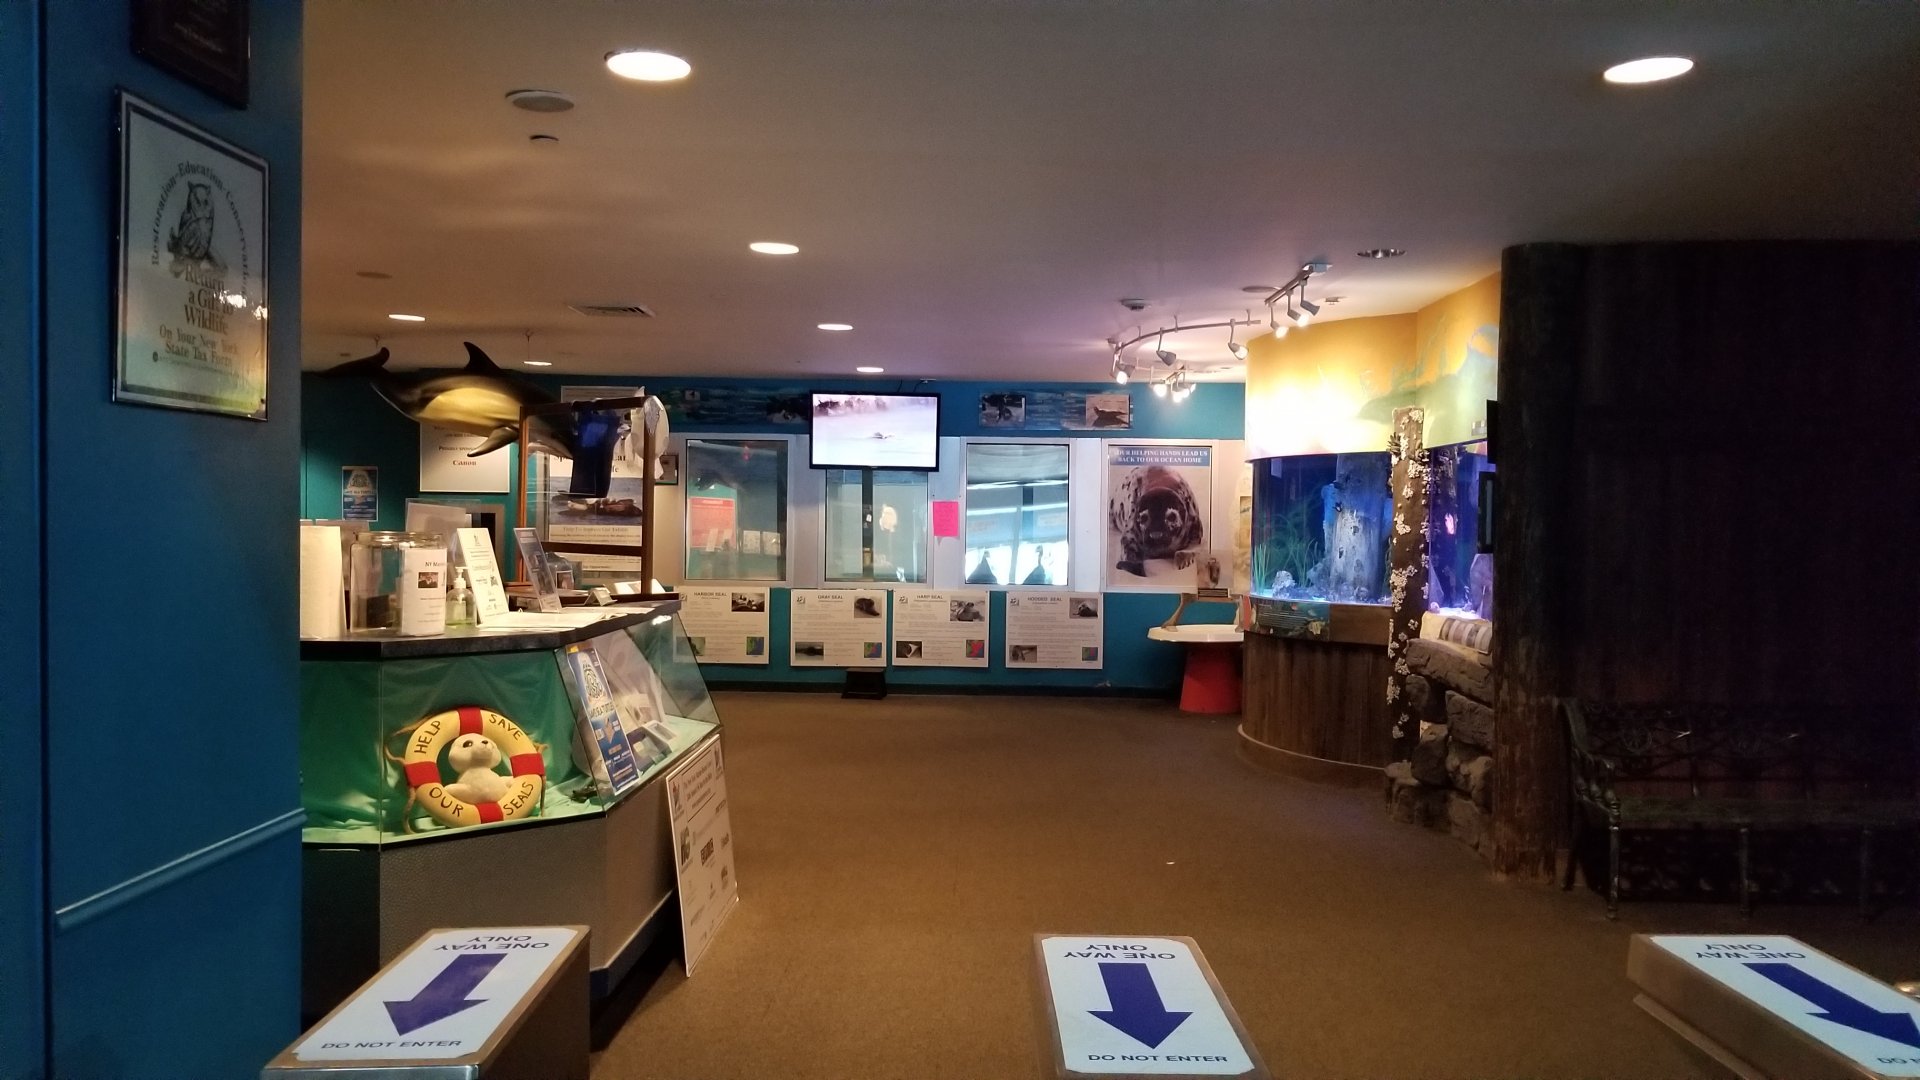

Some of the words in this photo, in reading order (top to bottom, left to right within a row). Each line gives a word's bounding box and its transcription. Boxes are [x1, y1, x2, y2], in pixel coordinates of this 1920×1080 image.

[185, 264, 225, 290] Return
[188, 291, 195, 304] a
[184, 304, 229, 336] Wildlife
[159, 324, 173, 339] On
[177, 327, 196, 345] Your
[165, 341, 189, 357] State
[414, 720, 441, 754] HELP
[489, 713, 523, 741] SAVE
[429, 787, 464, 817] OUR
[503, 781, 534, 816] SEALS
[434, 943, 487, 951] WAY
[1705, 943, 1768, 951] ONLY
[1063, 951, 1116, 959] WAY
[1124, 952, 1176, 960] ONE
[1696, 951, 1748, 959] WAY
[1756, 951, 1806, 959] ONE
[354, 1041, 396, 1049] NOT
[399, 1040, 462, 1048] ENTER
[1877, 1057, 1908, 1065] DO
